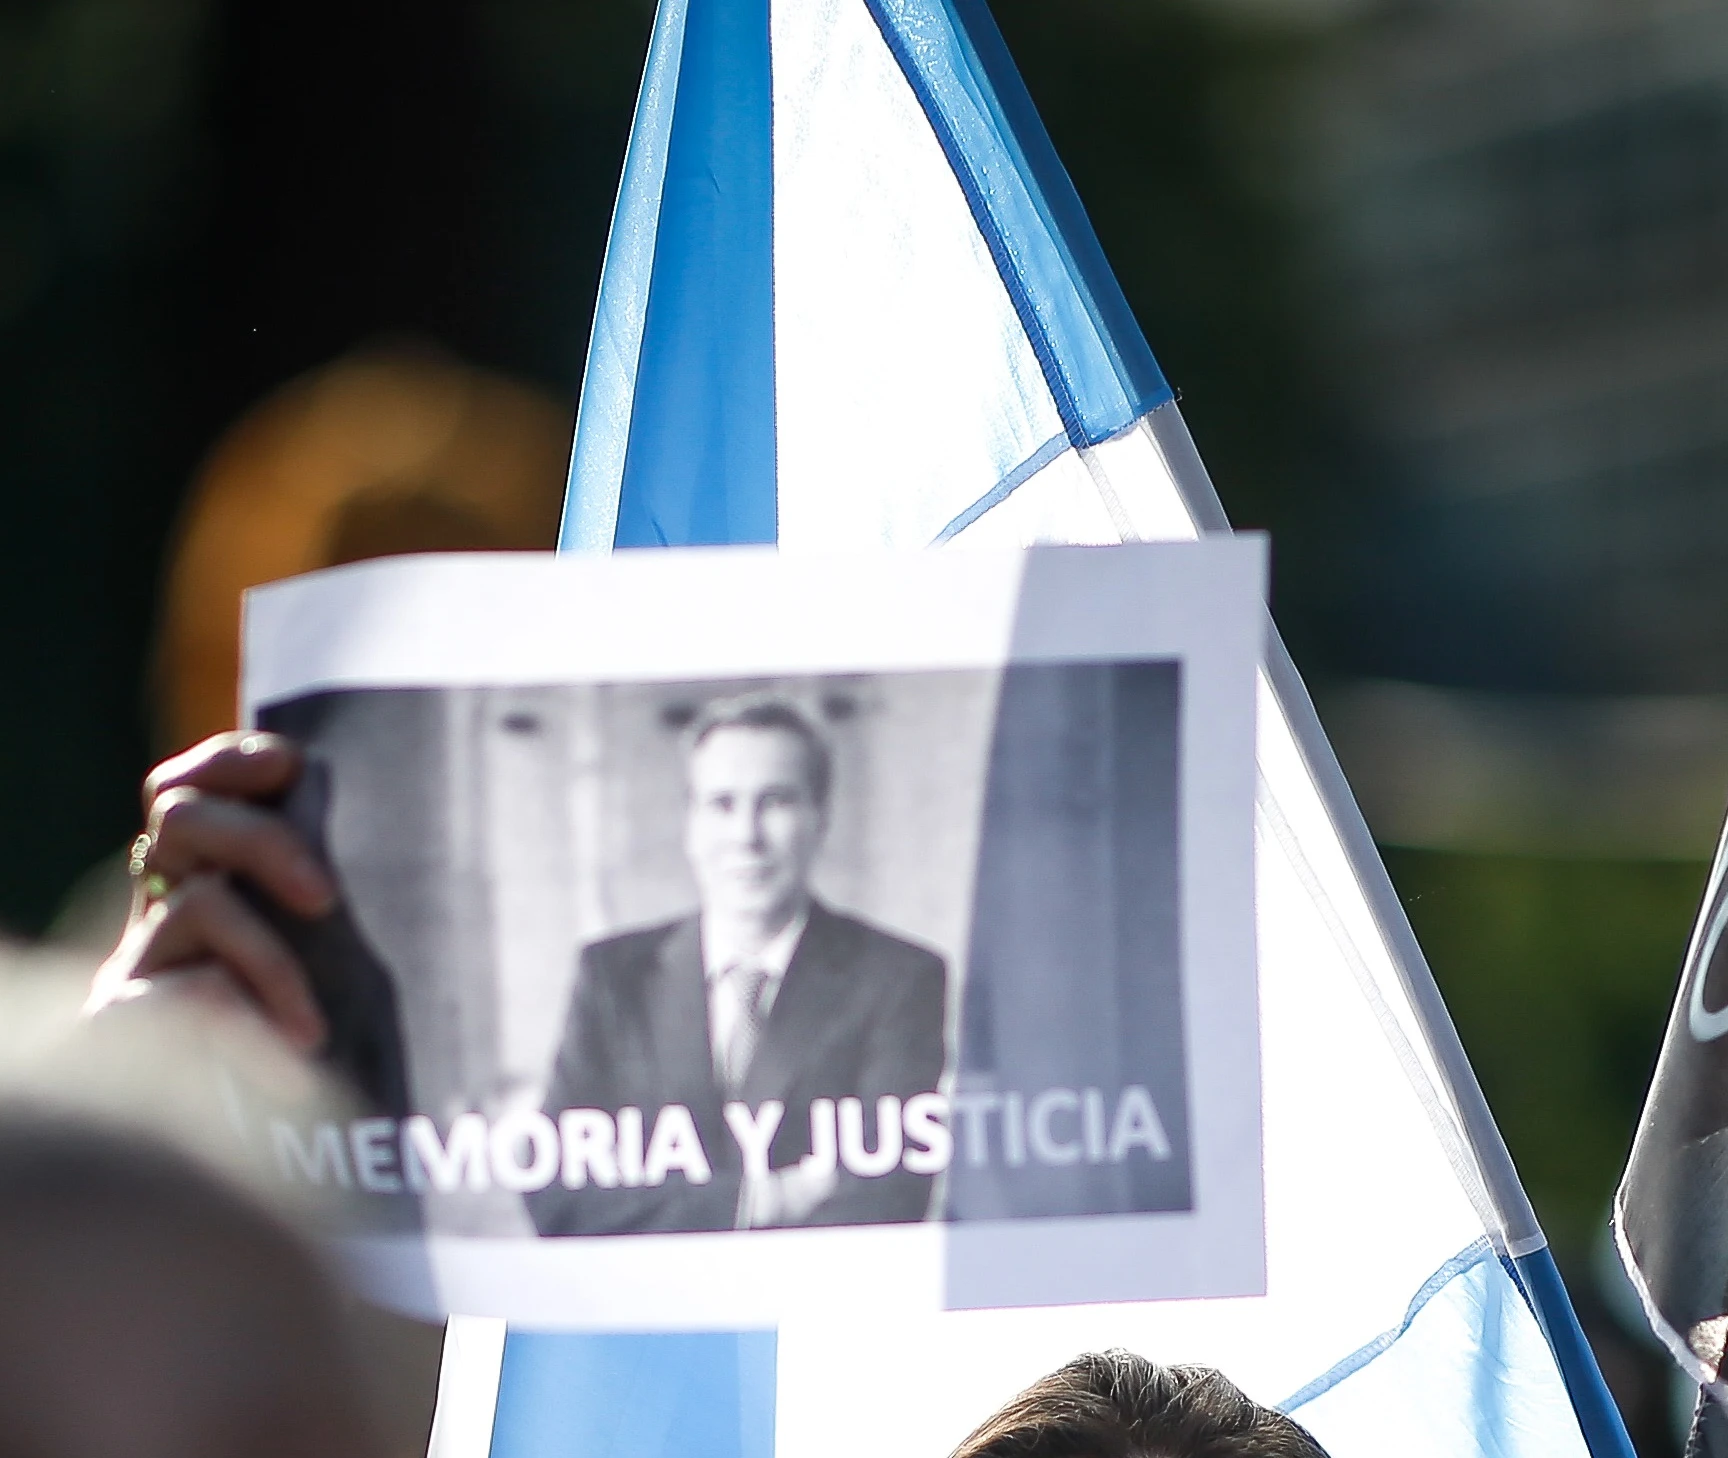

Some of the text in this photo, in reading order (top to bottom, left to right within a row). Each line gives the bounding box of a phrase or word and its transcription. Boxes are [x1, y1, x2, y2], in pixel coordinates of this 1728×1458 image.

[274, 1084, 1170, 1193] MEMORIA Y JUSTICIA
